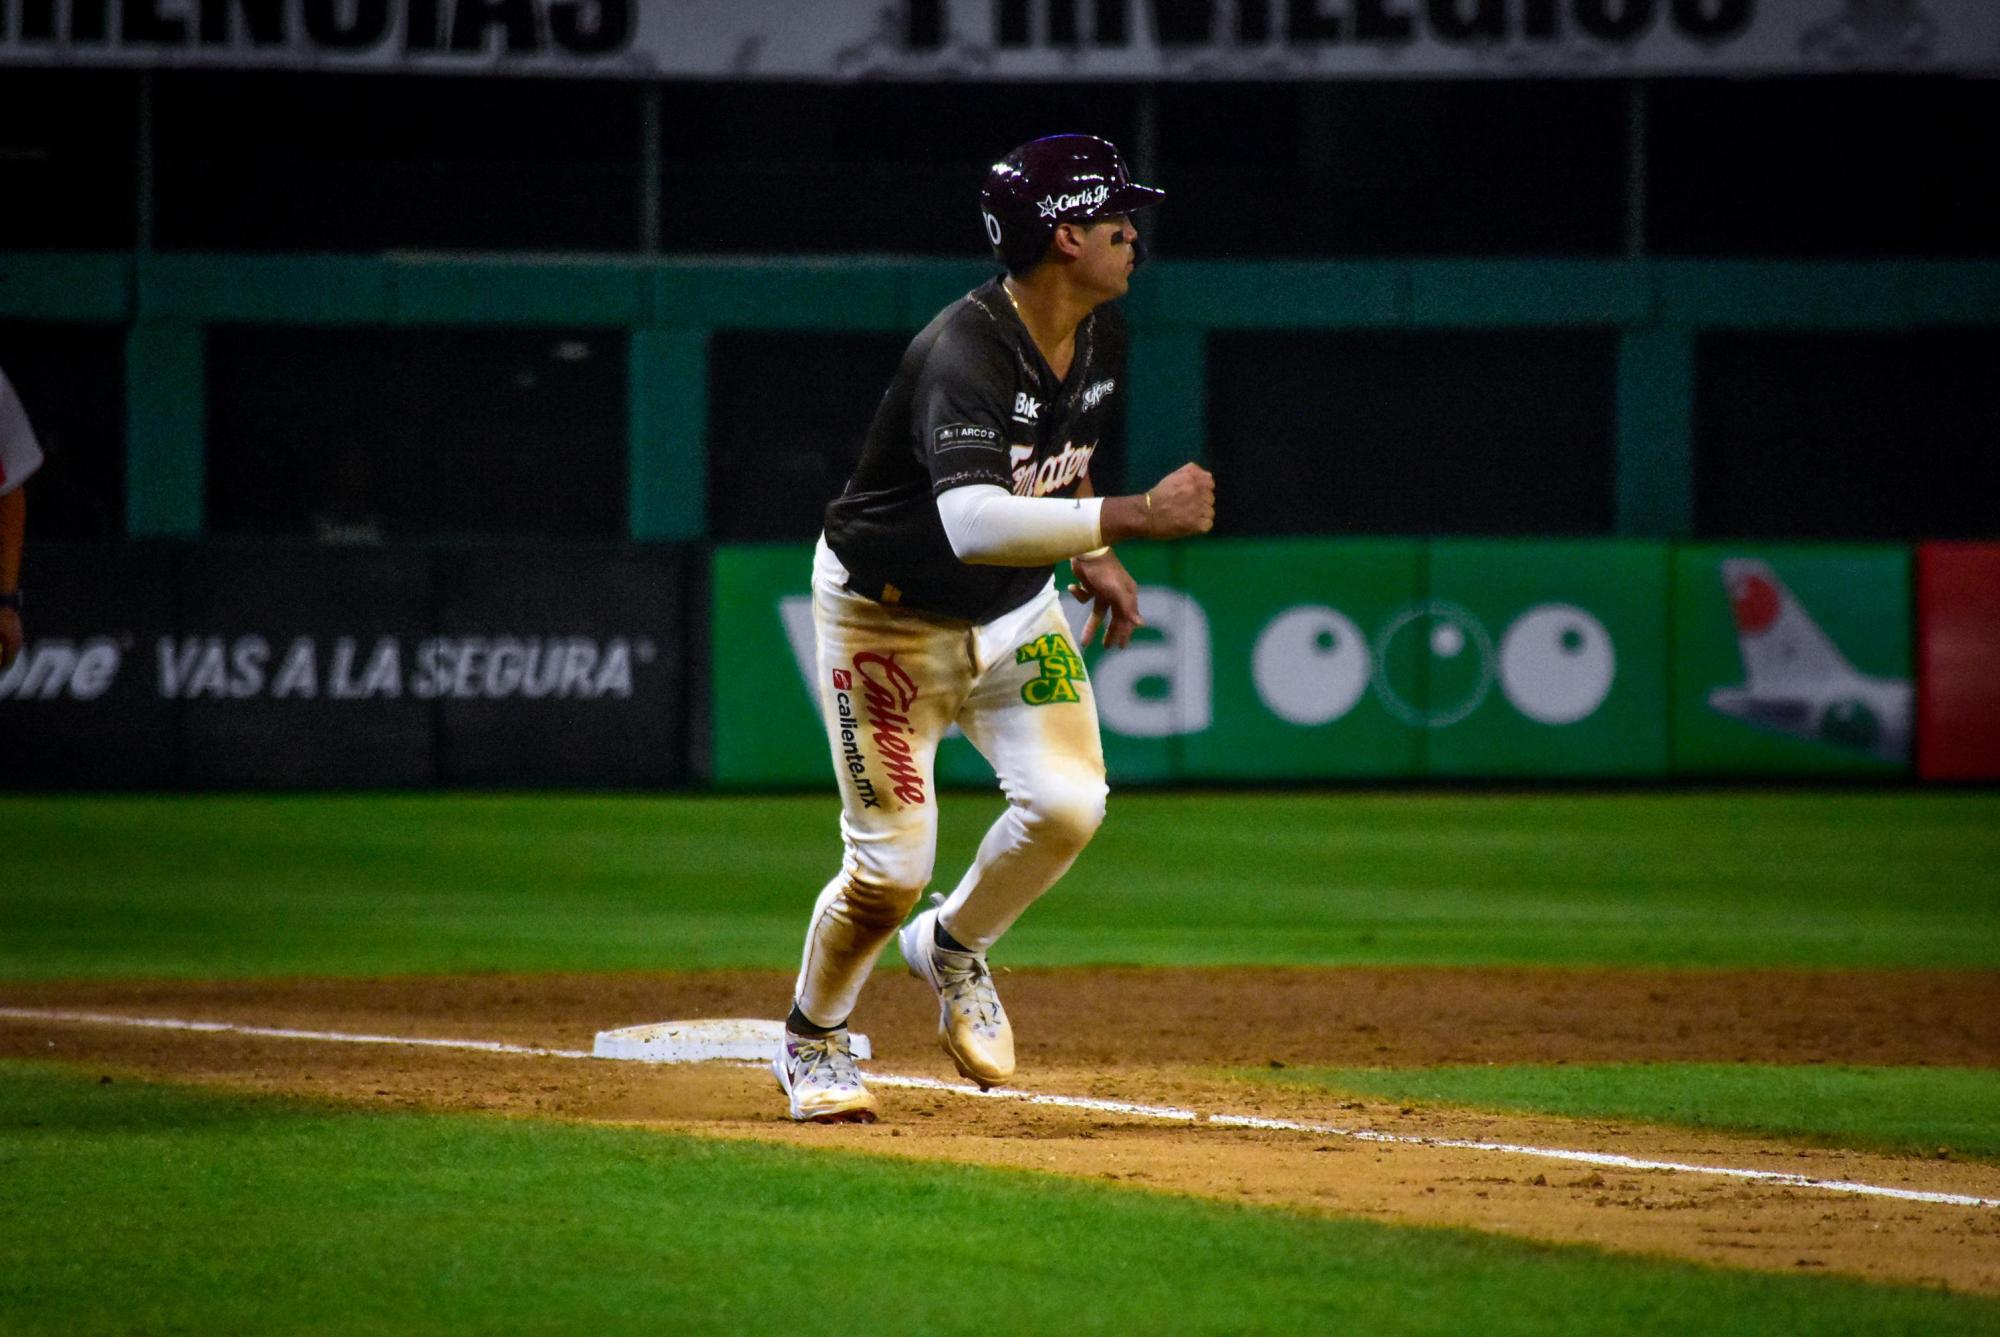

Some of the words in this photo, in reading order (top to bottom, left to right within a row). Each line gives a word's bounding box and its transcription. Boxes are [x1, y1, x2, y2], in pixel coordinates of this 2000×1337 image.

[1057, 188, 1093, 212] Carl's
[156, 633, 271, 699] VAS
[271, 633, 318, 699] A
[329, 633, 401, 699] LA
[409, 633, 634, 699] SEGURA
[837, 692, 881, 809] caliente.mx
[852, 651, 926, 805] Caliente
